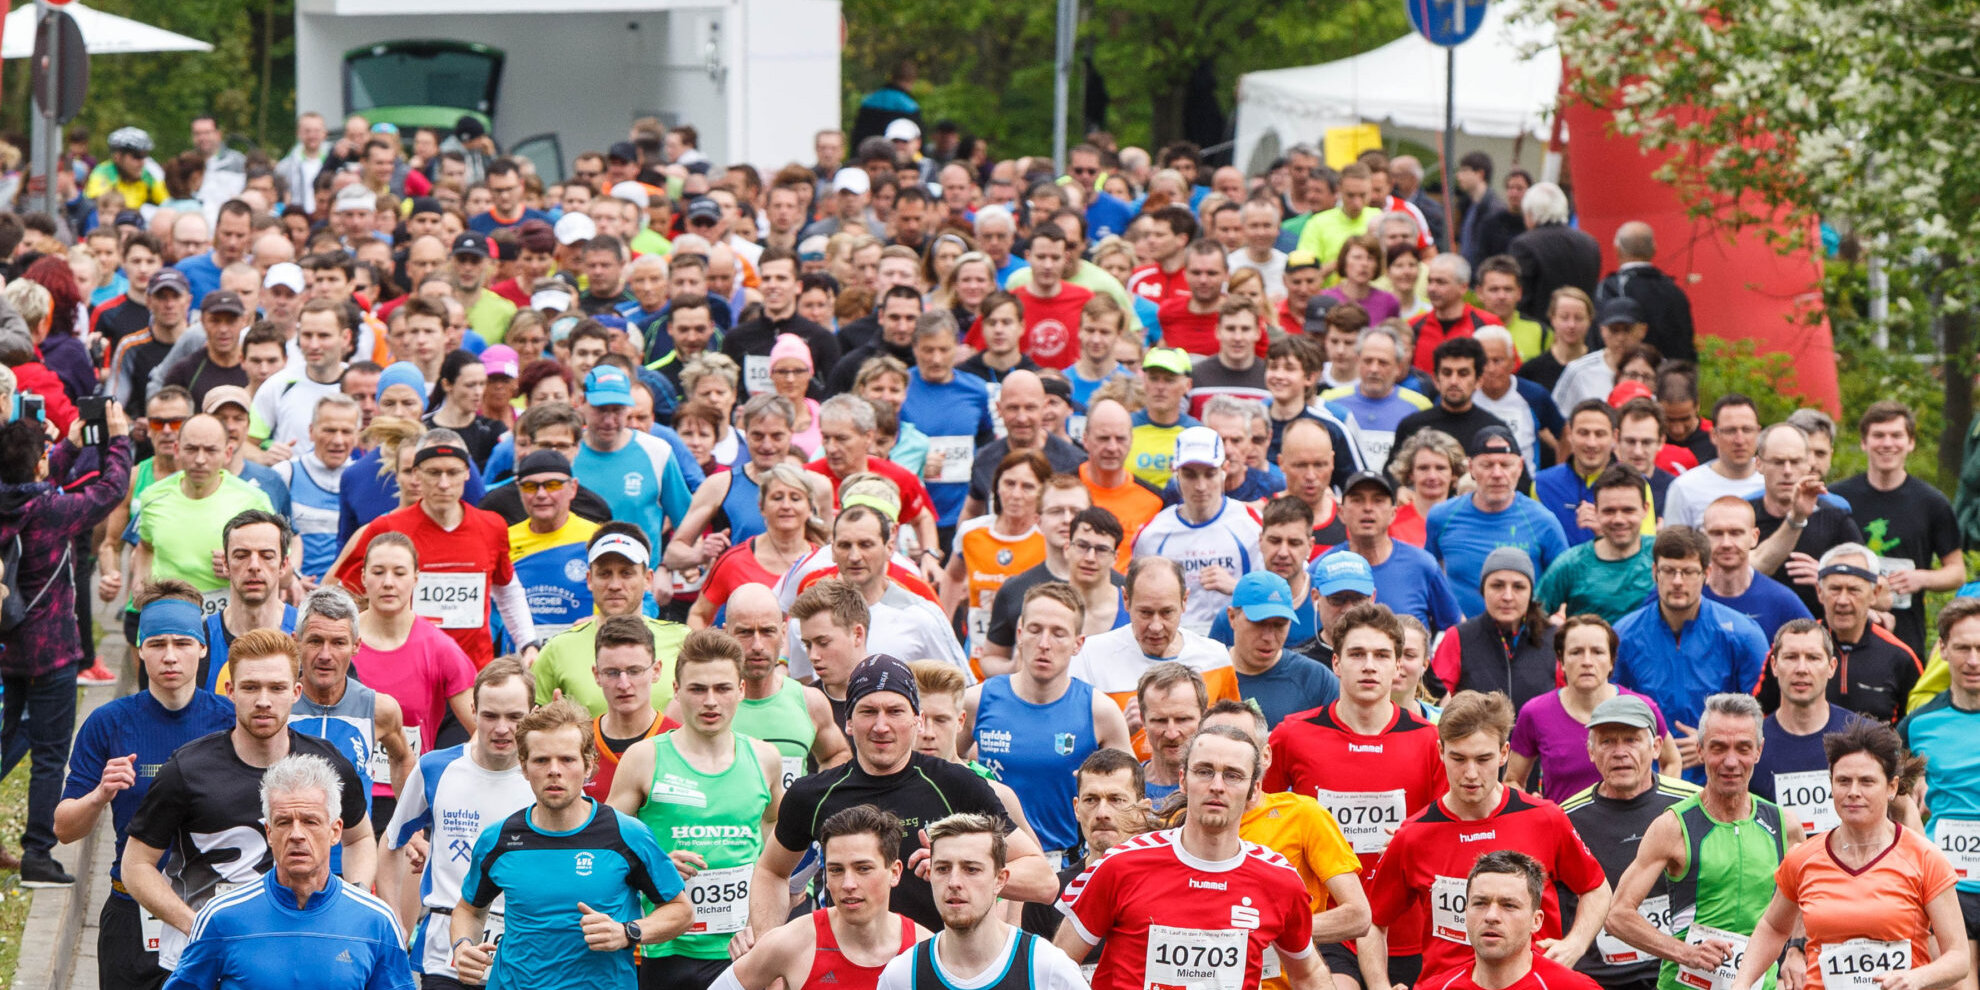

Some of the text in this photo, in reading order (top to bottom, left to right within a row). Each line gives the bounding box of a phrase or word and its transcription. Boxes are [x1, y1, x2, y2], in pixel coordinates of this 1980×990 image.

[419, 586, 478, 602] 10254
[1348, 743, 1384, 754] hummel
[443, 809, 480, 820] Laufclub
[1813, 807, 1828, 815] Jan
[443, 819, 479, 827] Oelsnitz
[671, 825, 753, 839] HONDA
[1343, 826, 1378, 835] Richard
[1459, 829, 1496, 843] hummel
[1188, 878, 1228, 891] hummel
[690, 880, 748, 905] 0358
[696, 904, 732, 914] Richard
[1155, 943, 1239, 968] 10703
[1828, 951, 1906, 975] 11642
[1176, 969, 1216, 978] Michael
